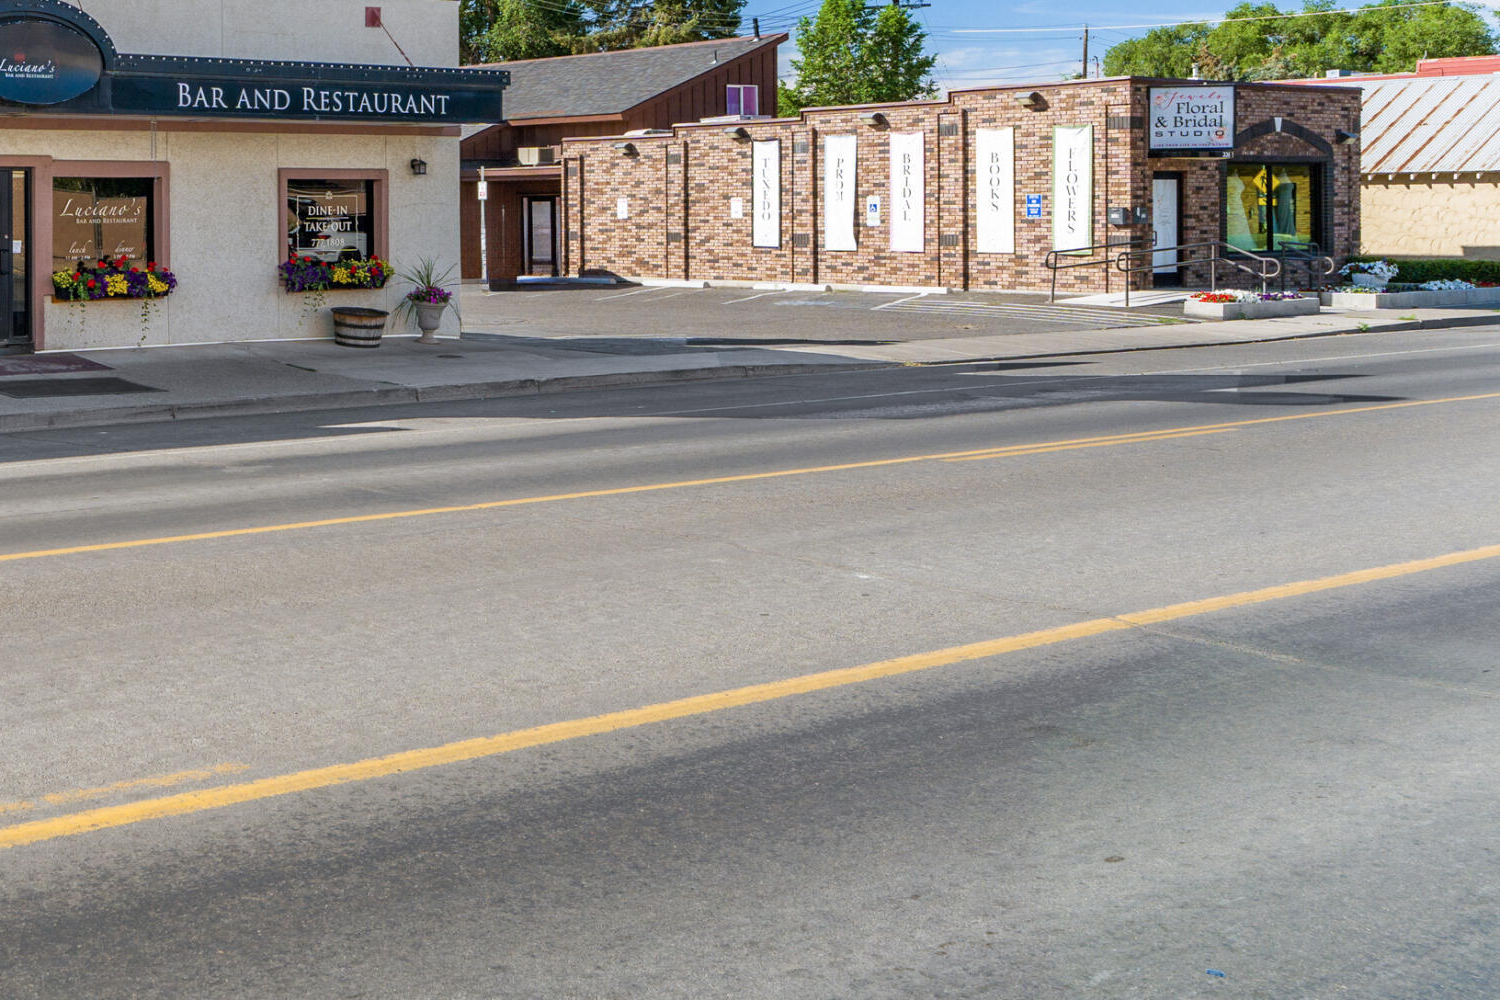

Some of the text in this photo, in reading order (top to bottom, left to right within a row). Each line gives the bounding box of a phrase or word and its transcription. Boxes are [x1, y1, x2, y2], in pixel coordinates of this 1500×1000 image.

[177, 82, 449, 115] BAR AND RESTAURANT
[1176, 101, 1224, 114] Floral
[1155, 115, 1223, 128] & Bridal
[903, 152, 911, 222] BRIDAL
[989, 151, 1000, 212] BOOKS
[1066, 147, 1079, 234] FLOWERS
[59, 198, 141, 217] Luciano's
[308, 205, 349, 216] DINE-IN
